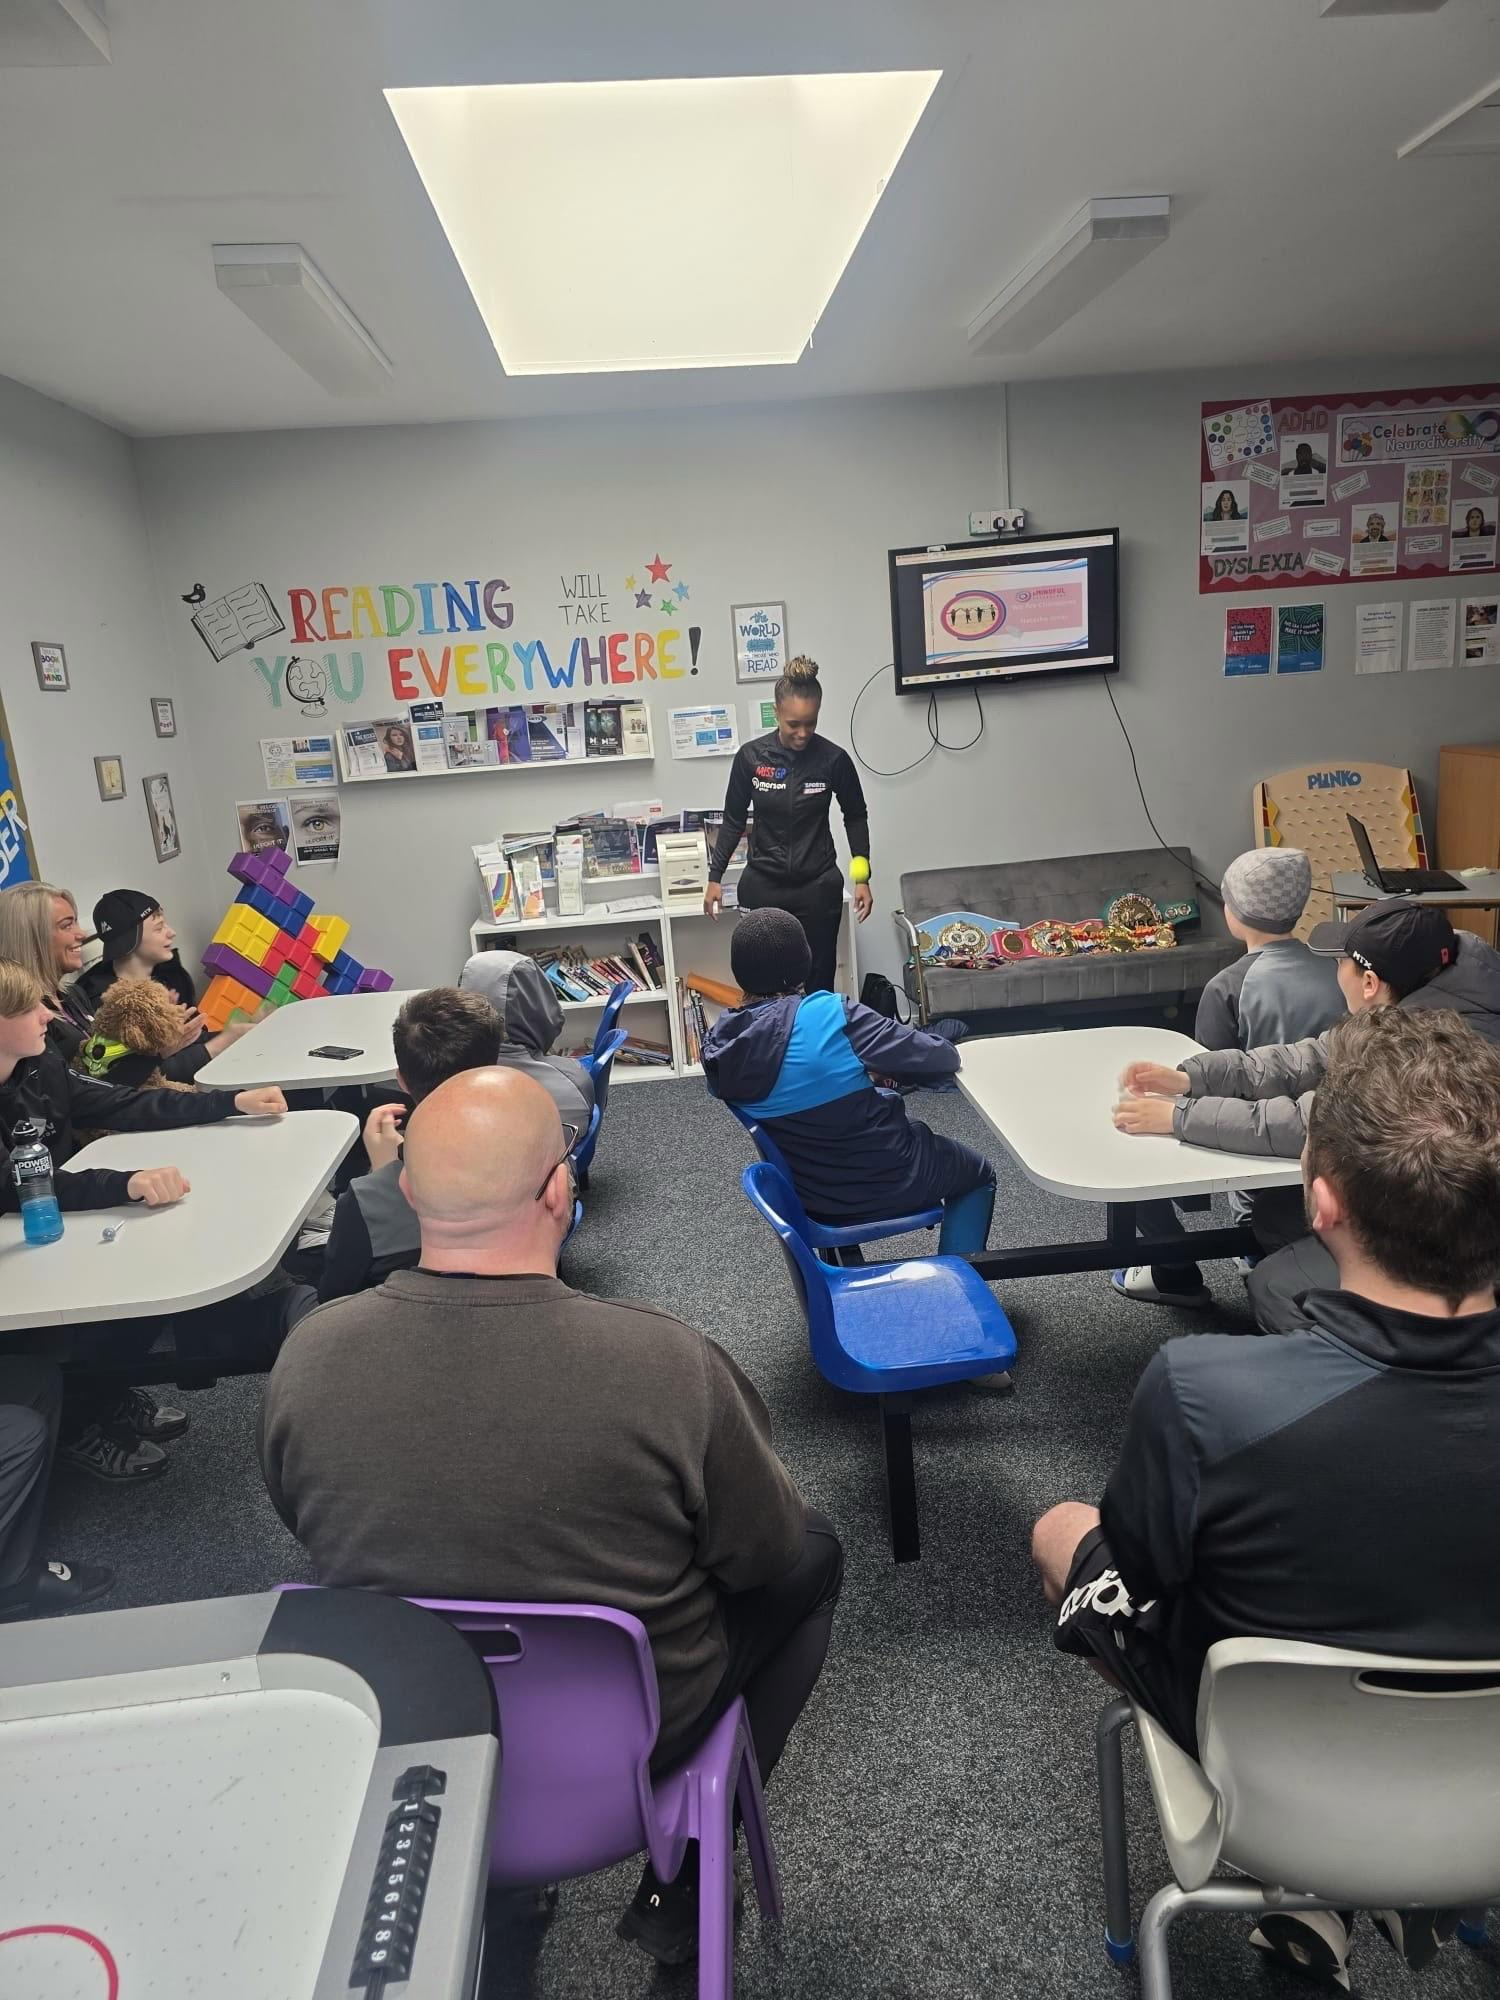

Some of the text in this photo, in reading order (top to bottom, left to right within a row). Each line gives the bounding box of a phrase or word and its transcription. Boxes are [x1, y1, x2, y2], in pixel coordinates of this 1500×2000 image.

[1278, 411, 1328, 433] ADHD
[1373, 423, 1447, 439] Celebrate
[1386, 434, 1487, 453] Neurodiversity
[1214, 553, 1304, 577] DYSLEXIA
[560, 573, 607, 600] WILL
[287, 578, 514, 644] READING
[558, 602, 611, 625] TAKE
[739, 622, 780, 638] WORLD
[250, 626, 702, 712] YOU EVERYWHERE!
[747, 658, 778, 673] READ
[756, 765, 776, 778] MISS
[1353, 950, 1372, 969] MTX
[18, 1156, 49, 1169] POWER
[371, 1803, 418, 1962] 1 2 3 4 5 6 7 8 9
